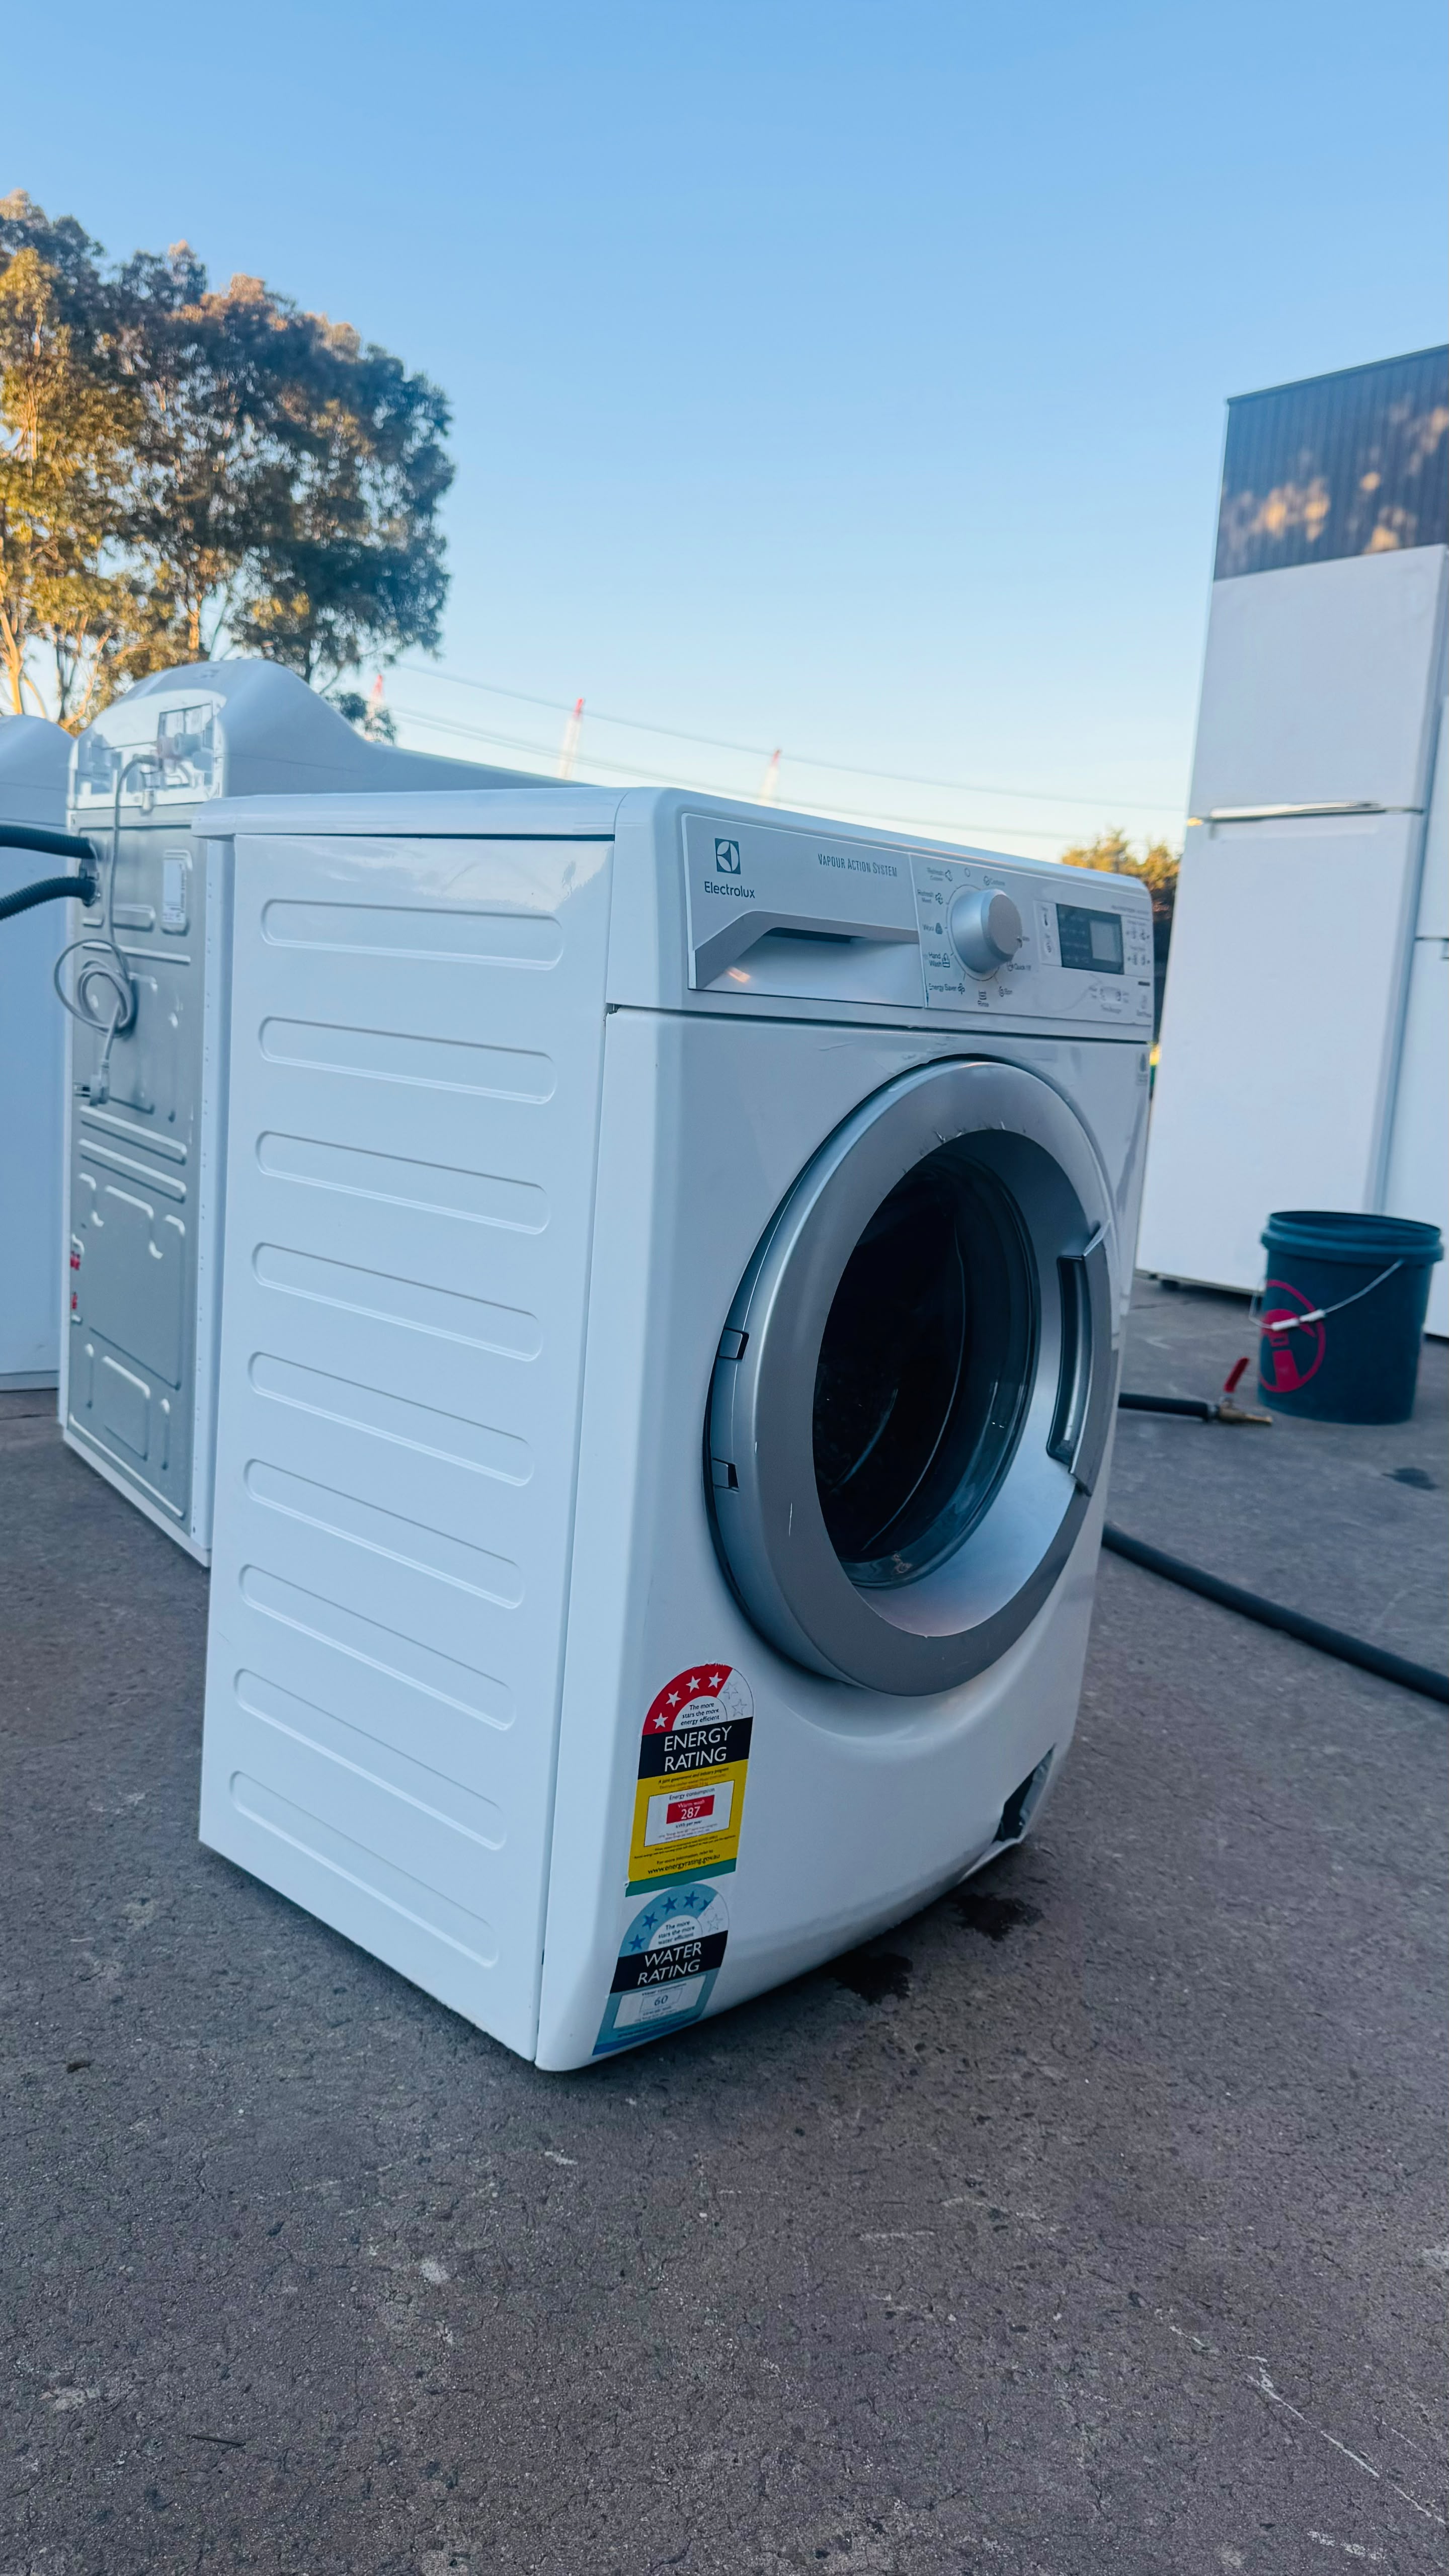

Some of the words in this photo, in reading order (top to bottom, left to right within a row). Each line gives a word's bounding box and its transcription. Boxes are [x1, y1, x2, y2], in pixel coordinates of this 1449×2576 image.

[818, 853, 845, 868] VAPOUR
[848, 858, 871, 873] ACTION
[873, 862, 898, 877] SYSTEM
[704, 881, 755, 899] Electrolux
[699, 1715, 720, 1723] efficient
[664, 1726, 732, 1752] ENERGY
[664, 1746, 727, 1772] RATING
[669, 1793, 685, 1801] Energy
[686, 1787, 715, 1798] consumption
[681, 1805, 701, 1820] 287
[648, 1854, 720, 1874] www.energyrating.gov.au
[674, 1933, 694, 1942] efficient
[645, 1942, 702, 1967] WATER
[637, 1959, 701, 1985] RATING
[654, 1995, 669, 2006] 60
